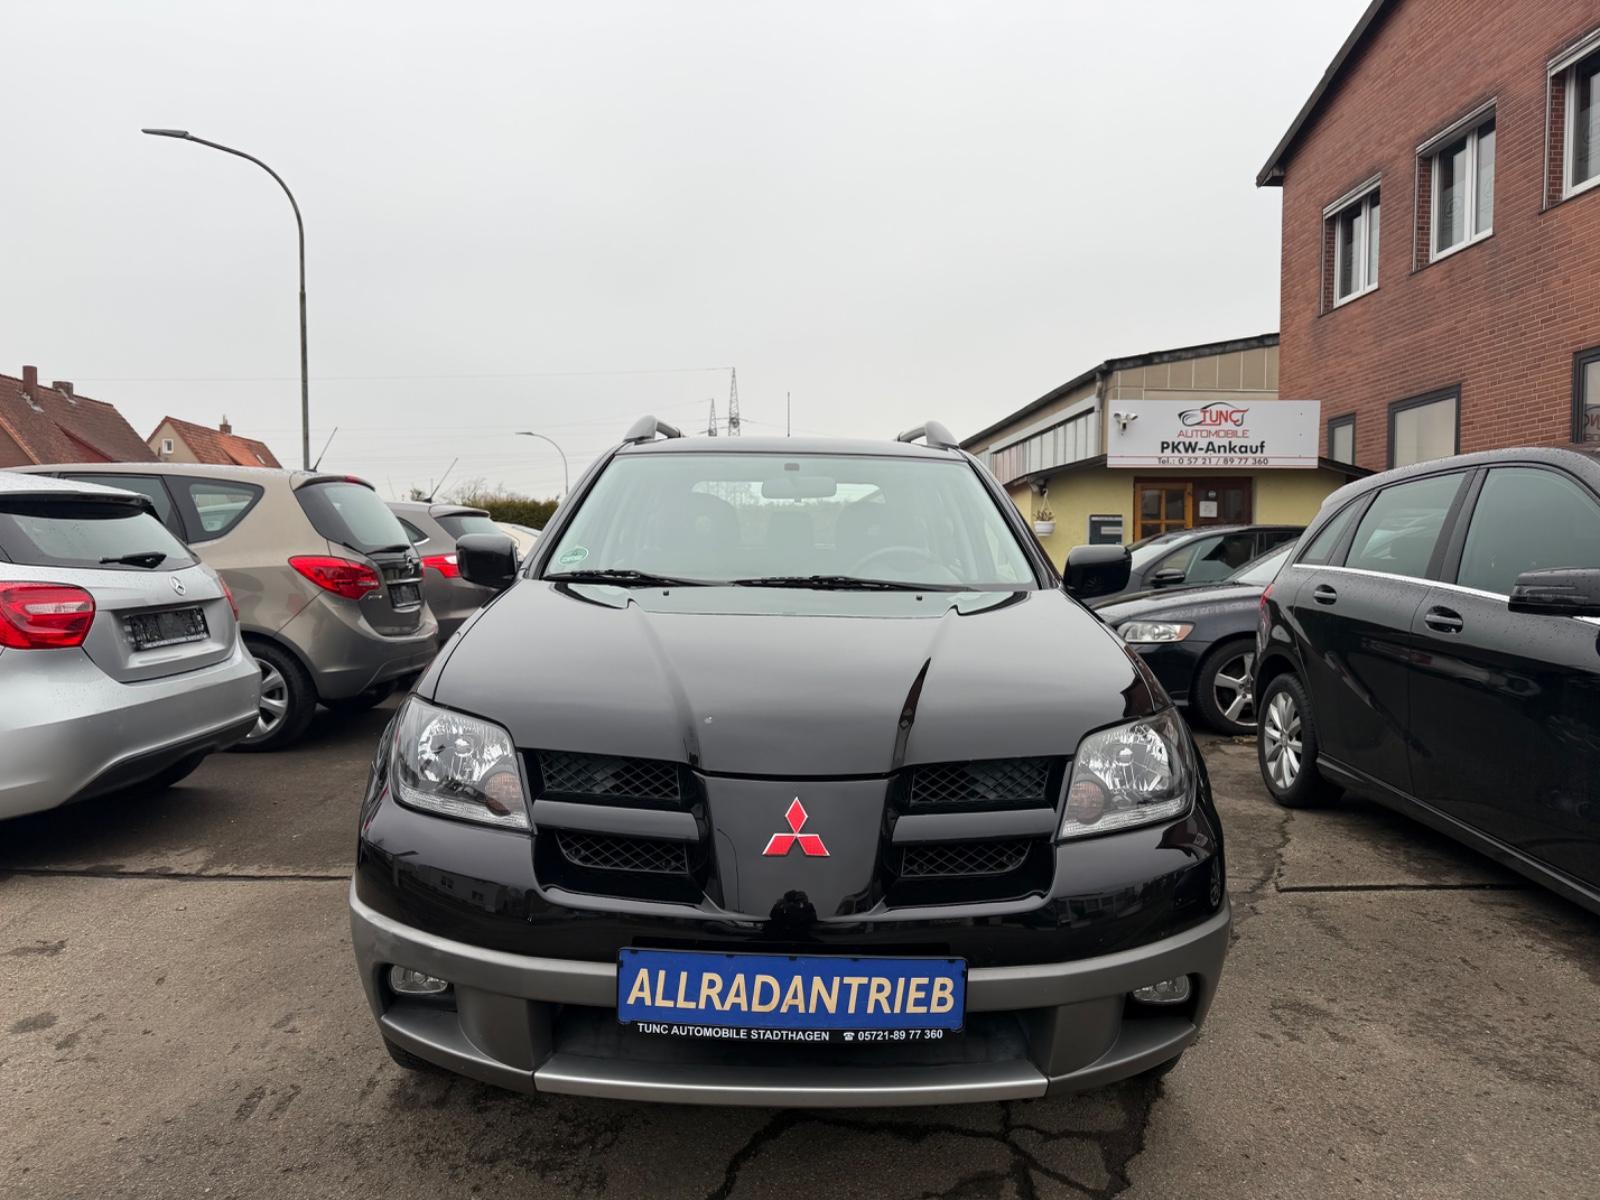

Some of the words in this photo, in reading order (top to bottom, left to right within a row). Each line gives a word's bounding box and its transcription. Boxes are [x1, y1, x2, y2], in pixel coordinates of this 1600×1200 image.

[1177, 429, 1249, 439] AUTOMOBILE
[1160, 441, 1265, 454] PKW-Ankauf
[1178, 457, 1184, 465] 0
[1187, 457, 1198, 465] 57
[1202, 457, 1212, 465] 21
[1223, 457, 1234, 465] 89
[1238, 457, 1248, 465] 77
[1252, 457, 1269, 465] 360
[627, 968, 955, 1014] ALLRADANTRIEB
[637, 1022, 669, 1034] TUNC
[671, 1025, 748, 1039] AUTOMOBILE
[750, 1029, 830, 1041] STADTHAGEN
[857, 1030, 906, 1041] 05721-89
[909, 1030, 921, 1040] 77
[924, 1029, 943, 1040] 360
